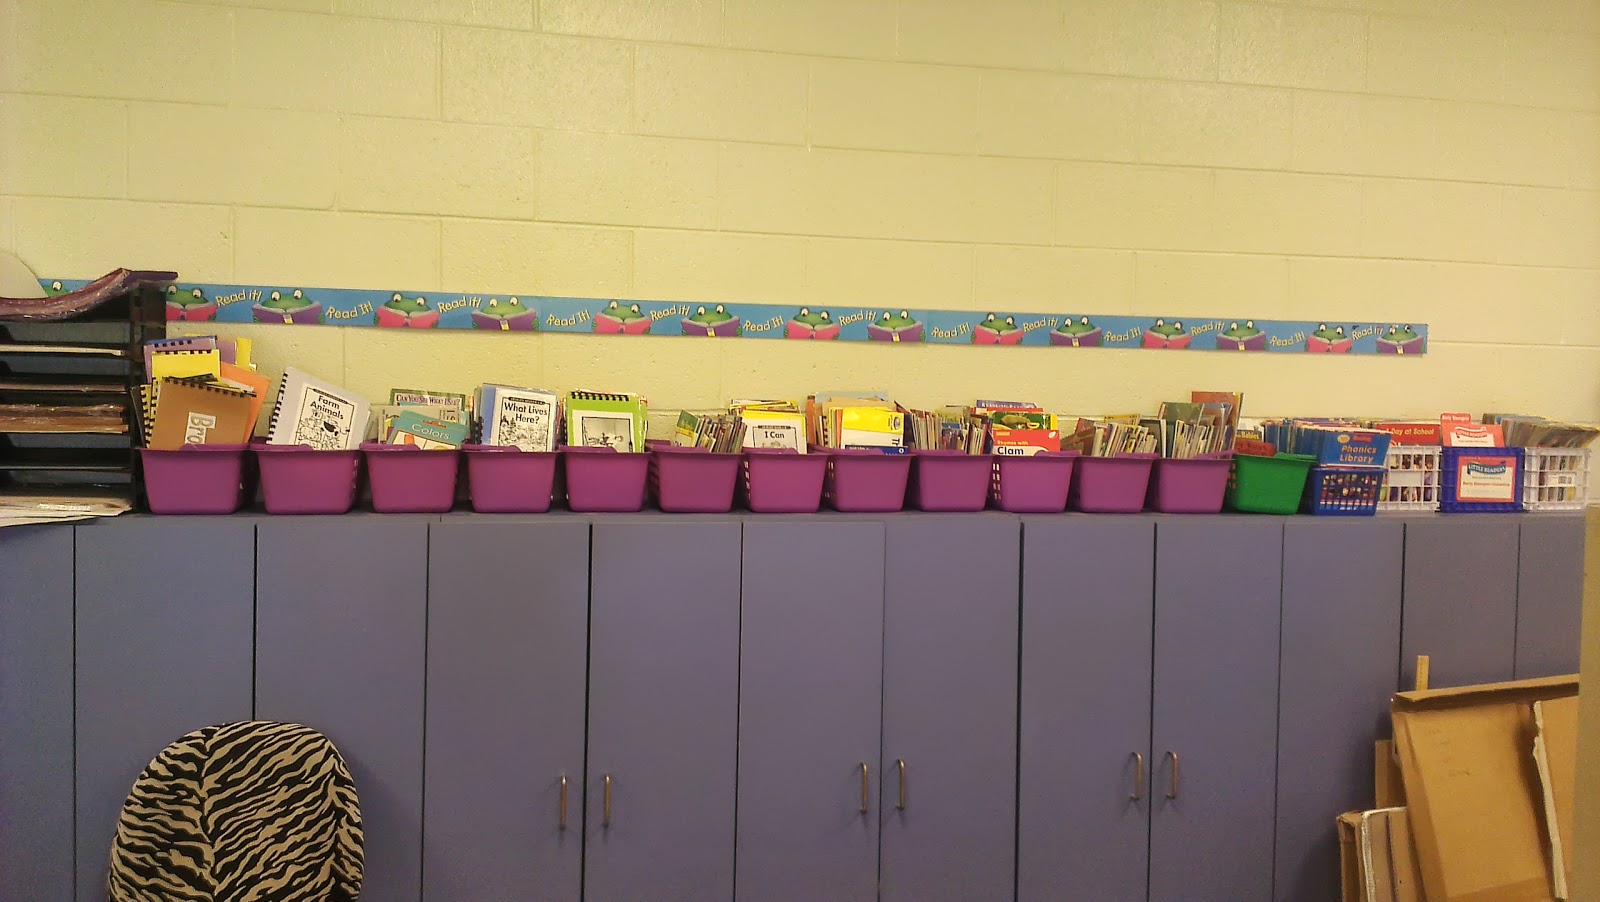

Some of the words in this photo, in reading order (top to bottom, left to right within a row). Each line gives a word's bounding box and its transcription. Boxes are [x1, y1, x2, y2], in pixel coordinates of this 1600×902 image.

[215, 290, 246, 307] Read
[437, 296, 467, 314] Read
[326, 306, 358, 320] Read
[650, 304, 677, 321] Read
[838, 310, 864, 326] Read
[545, 314, 576, 327] Read
[743, 319, 771, 332] Read
[1023, 317, 1046, 333] Read
[931, 326, 958, 339] Read
[1190, 321, 1213, 336] Read
[1351, 327, 1373, 340] Read
[1104, 330, 1129, 343] Read
[1270, 335, 1294, 348] Read
[318, 395, 340, 409] Farm
[310, 401, 344, 420] Animals
[504, 402, 526, 413] What
[528, 405, 548, 416] Lives
[515, 413, 540, 425] Here?
[411, 423, 451, 440] Colors
[769, 431, 785, 439] Can
[1391, 428, 1403, 436] Day
[997, 446, 1024, 455] Clam
[1341, 445, 1377, 454] Phonics
[1340, 454, 1374, 465] Library
